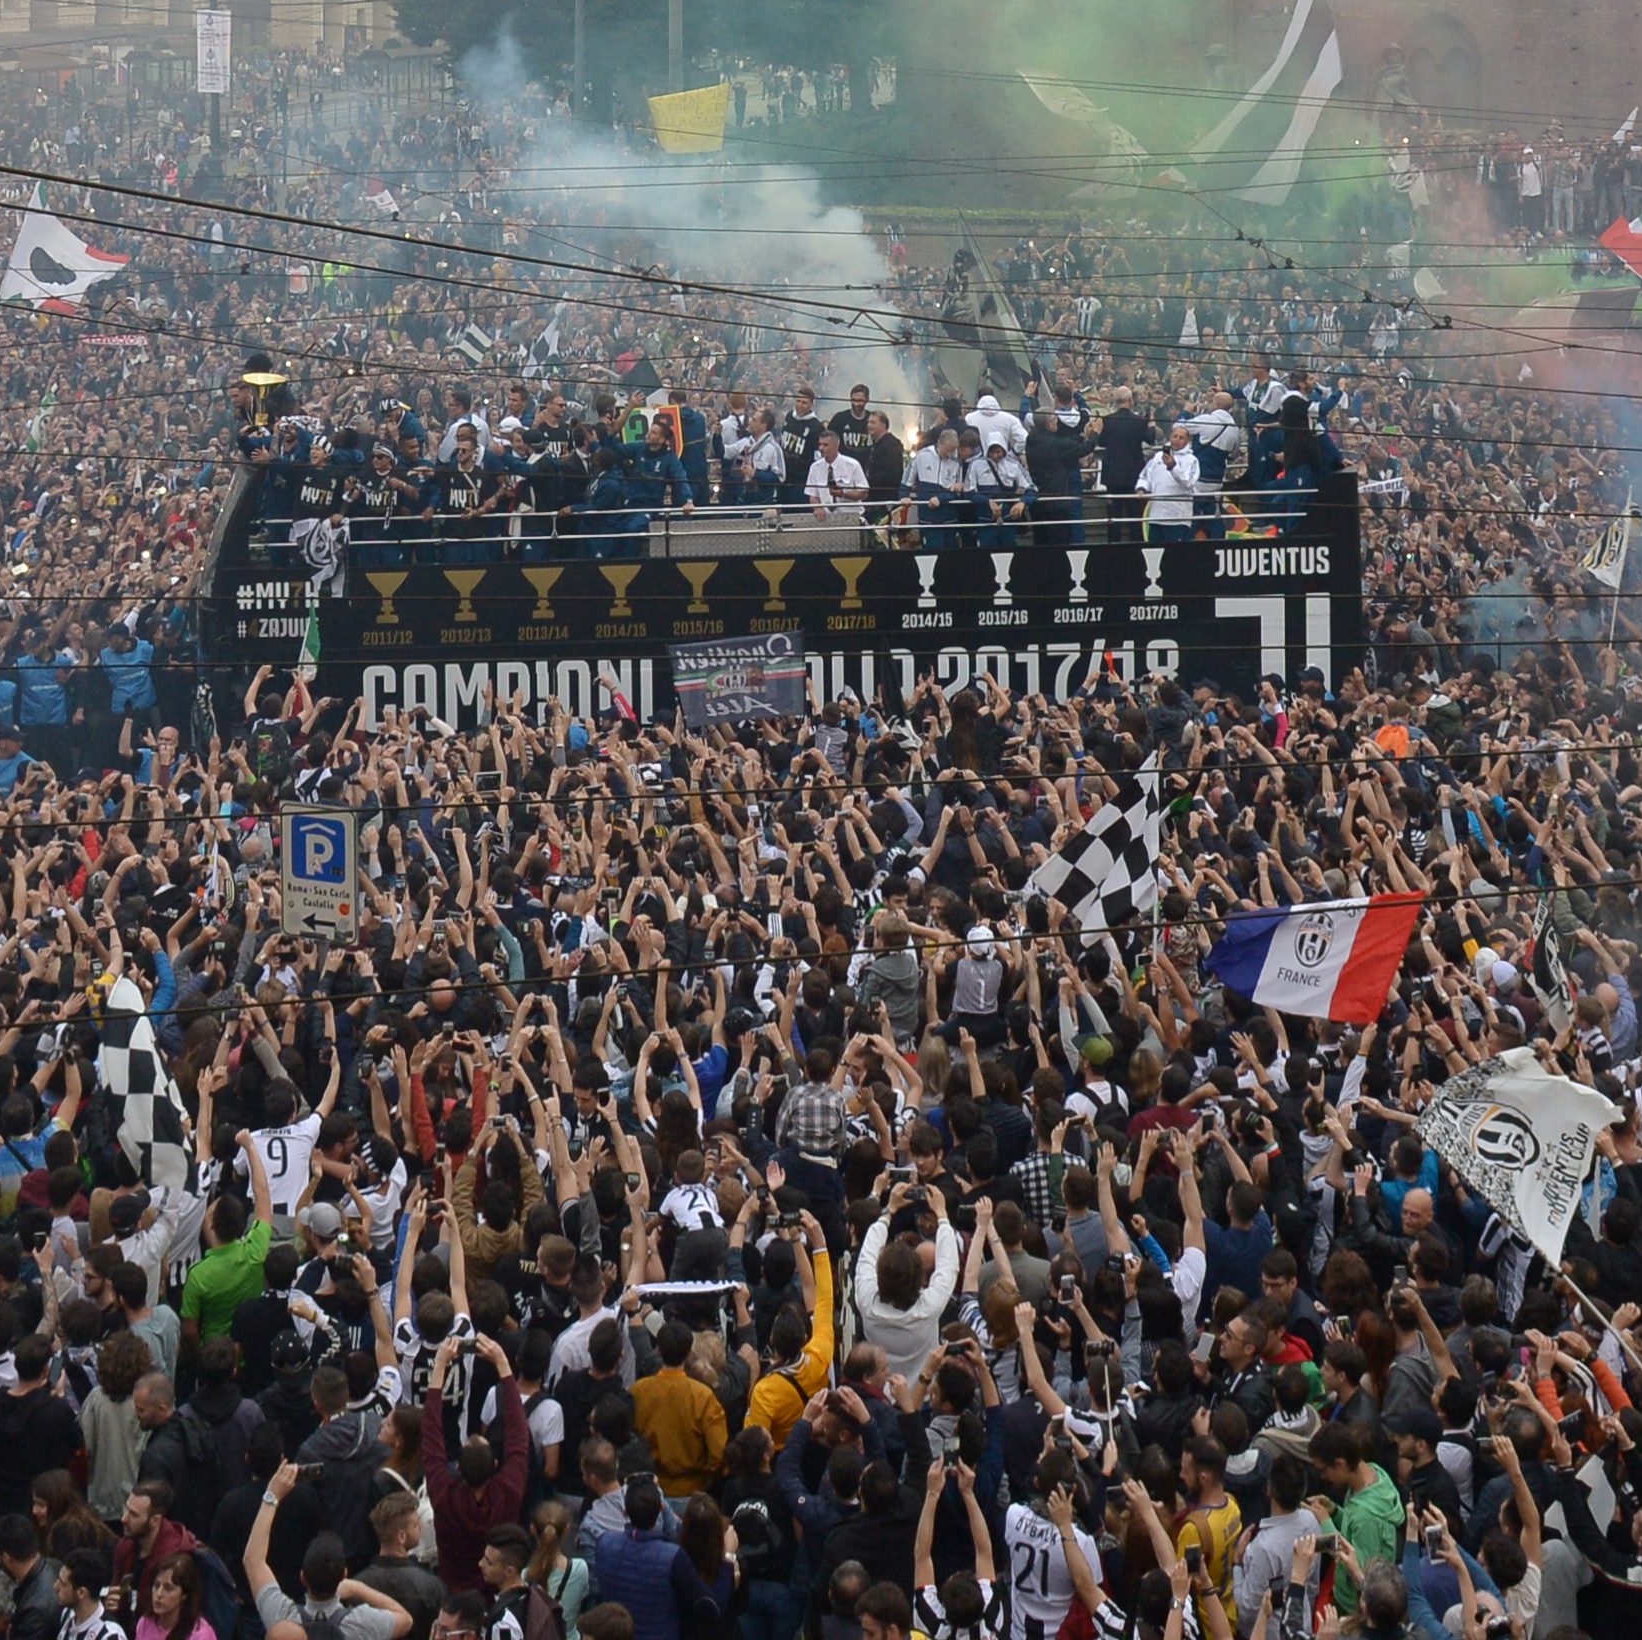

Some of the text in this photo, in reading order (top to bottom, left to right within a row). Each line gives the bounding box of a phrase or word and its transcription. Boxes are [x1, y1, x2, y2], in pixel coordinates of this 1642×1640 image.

[301, 484, 333, 507] MY7H
[1215, 546, 1330, 578] JUVENTUS
[902, 612, 953, 629] 2014/15
[978, 610, 1028, 626] 2015/16
[1054, 607, 1104, 624] 2016/17
[1129, 605, 1178, 622] 2017/18
[596, 622, 647, 638] 2014/15
[673, 620, 724, 636] 2015/16
[750, 617, 800, 633] 2016/17
[827, 615, 877, 631] 2017/18
[362, 630, 413, 647] 2011/12
[440, 628, 492, 645] 2012/13
[517, 625, 570, 643] 2013/14
[363, 659, 654, 735] CAMPIONI
[937, 639, 1179, 707] 2017/18
[305, 833, 334, 876] P
[287, 882, 308, 894] Roma
[313, 886, 328, 897] San
[329, 888, 350, 899] Carlo
[303, 898, 335, 910] Castello
[1277, 967, 1322, 988] FRANCE
[977, 978, 986, 1010] 1
[1571, 1122, 1592, 1164] CLUB
[267, 1136, 289, 1179] 9
[1015, 1519, 1058, 1547] DYBALA
[1014, 1542, 1051, 1598] 21
